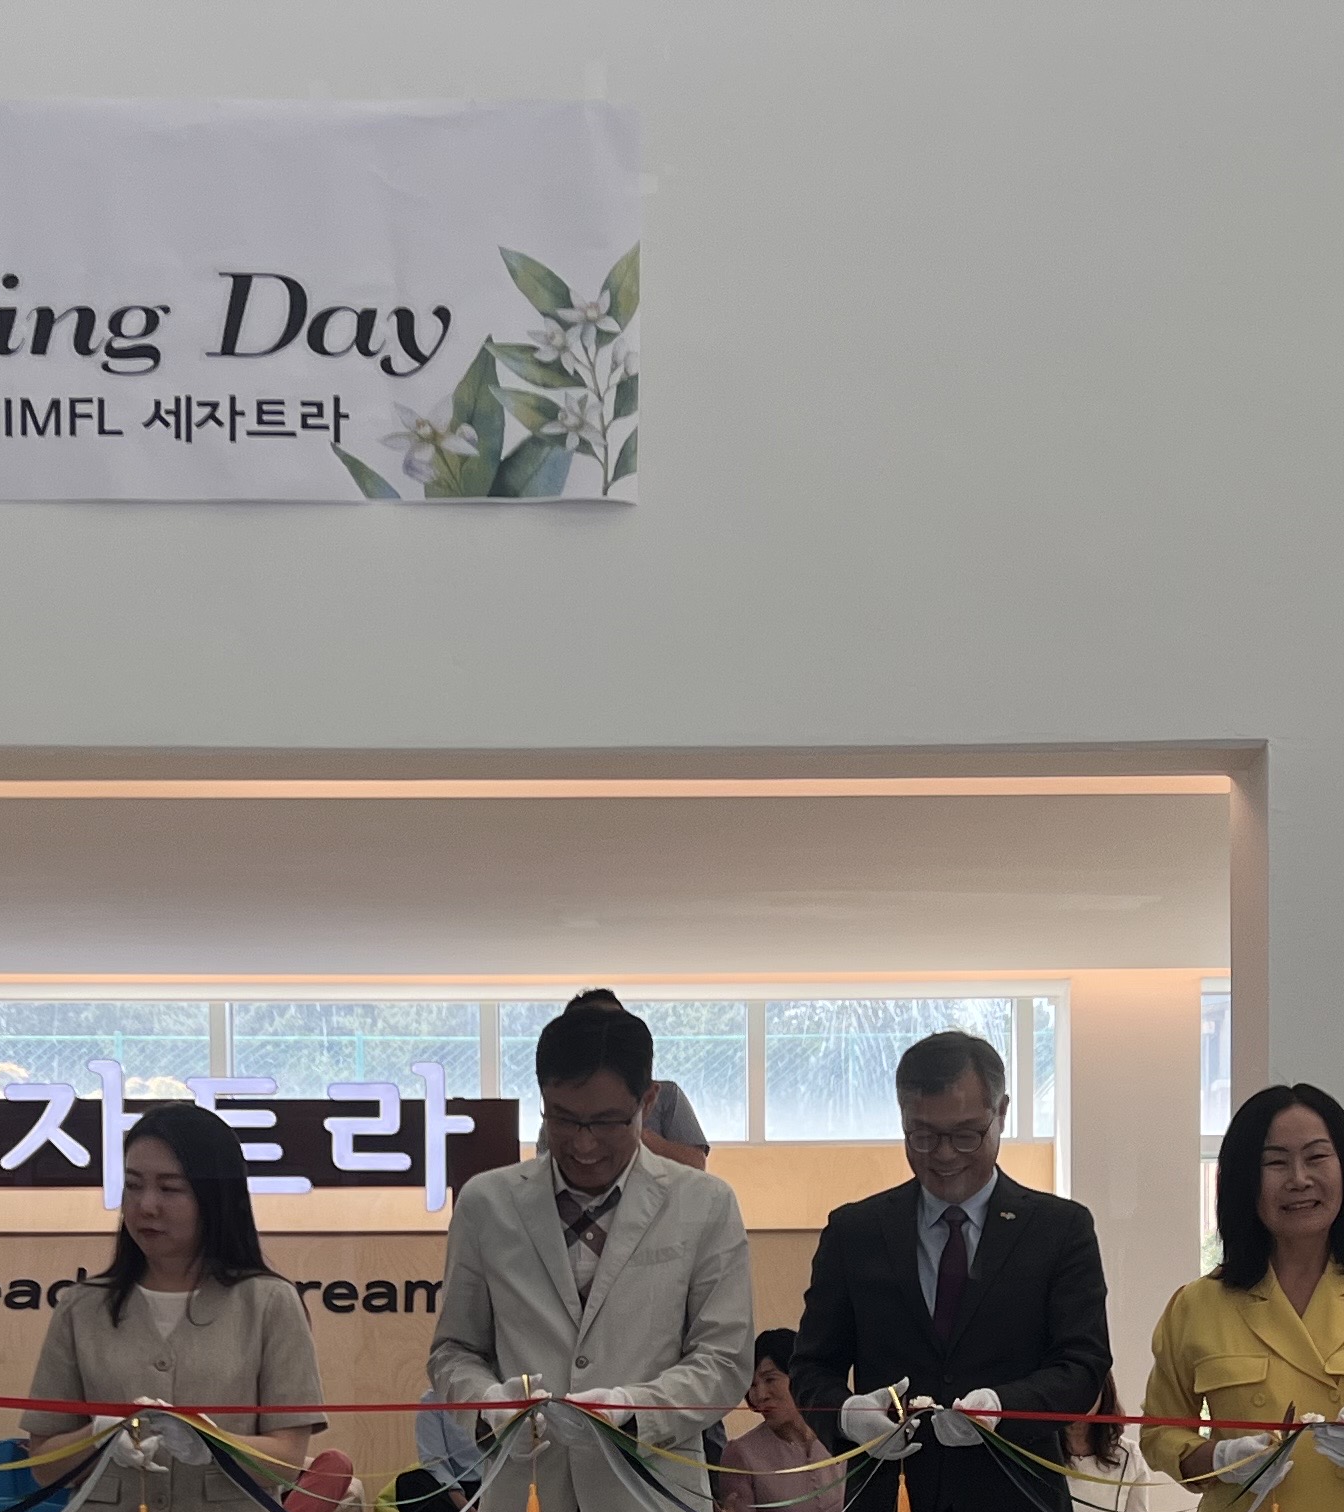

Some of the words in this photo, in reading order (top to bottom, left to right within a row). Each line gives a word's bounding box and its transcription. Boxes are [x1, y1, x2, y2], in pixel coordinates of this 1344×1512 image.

[205, 272, 452, 378] Day
[142, 395, 350, 444] 세자트라
[295, 1279, 443, 1313] ream
